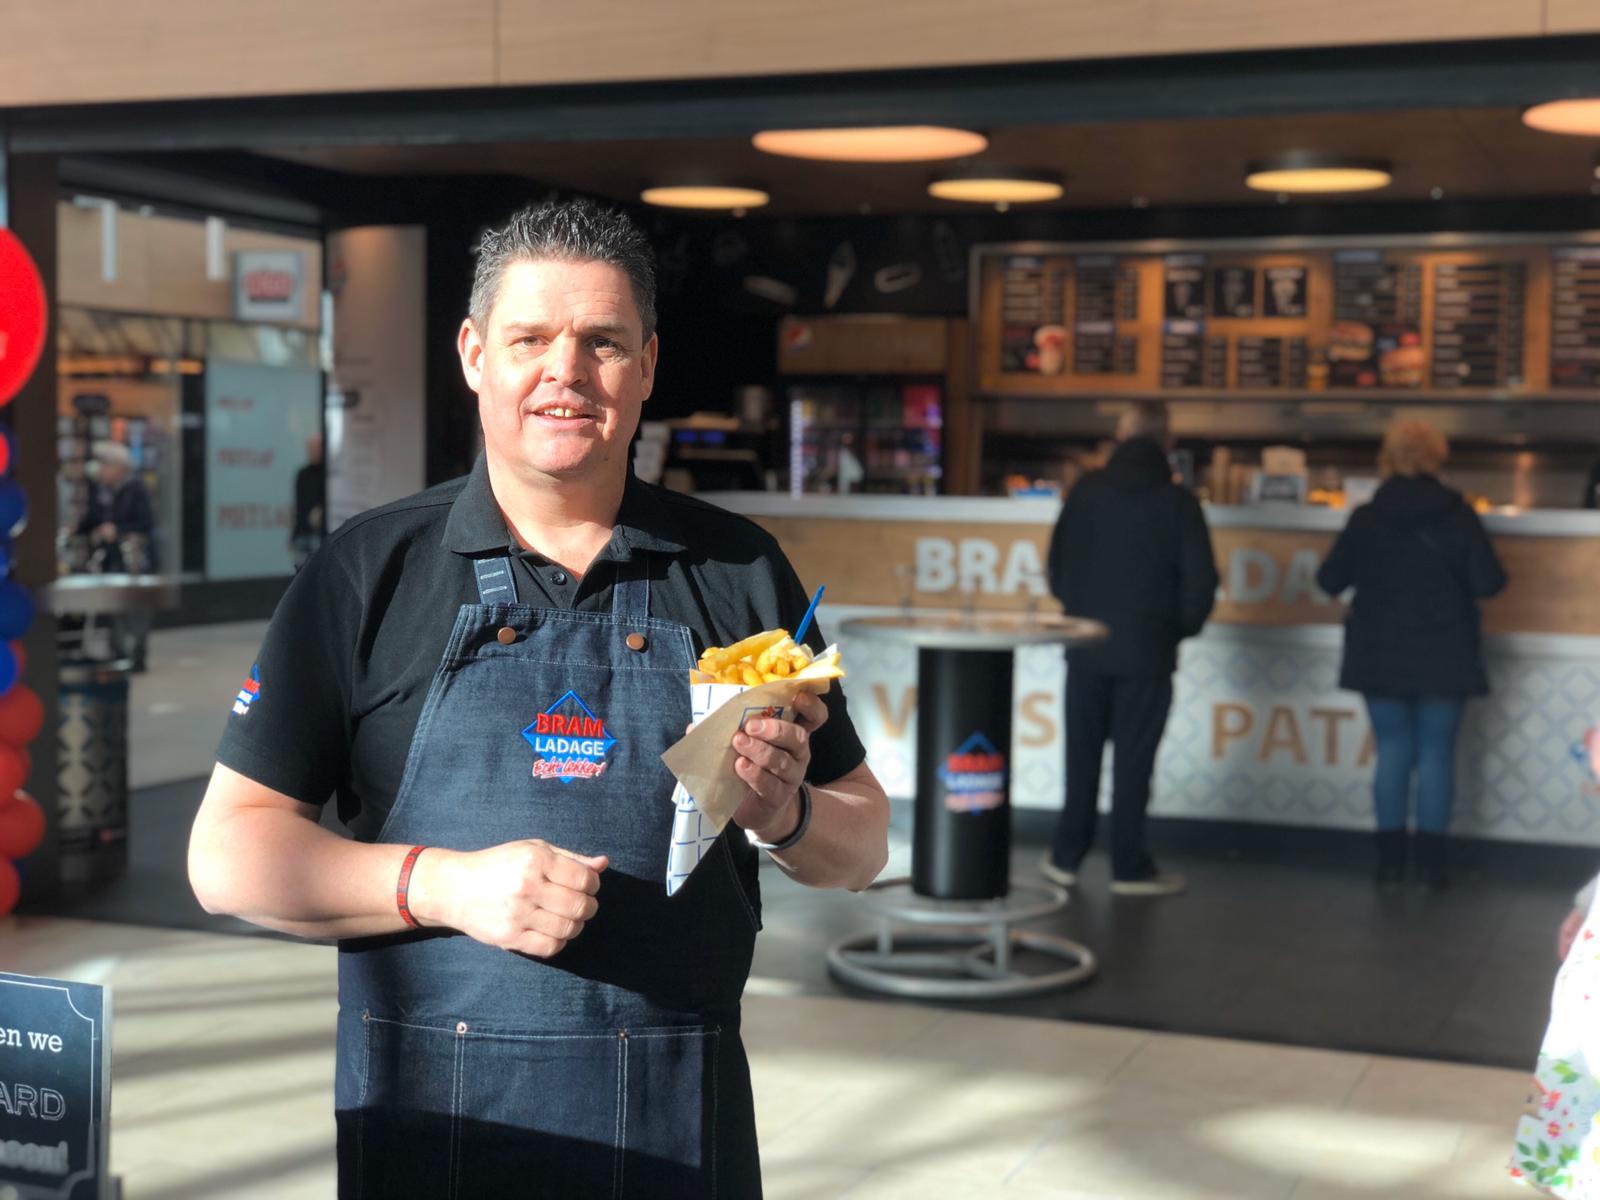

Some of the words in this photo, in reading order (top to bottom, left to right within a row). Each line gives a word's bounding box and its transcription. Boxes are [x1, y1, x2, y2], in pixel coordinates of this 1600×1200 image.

[915, 537, 1047, 596] BRA
[536, 712, 604, 738] BRAM
[535, 736, 605, 756] LADAGE
[27, 1031, 63, 1053] we
